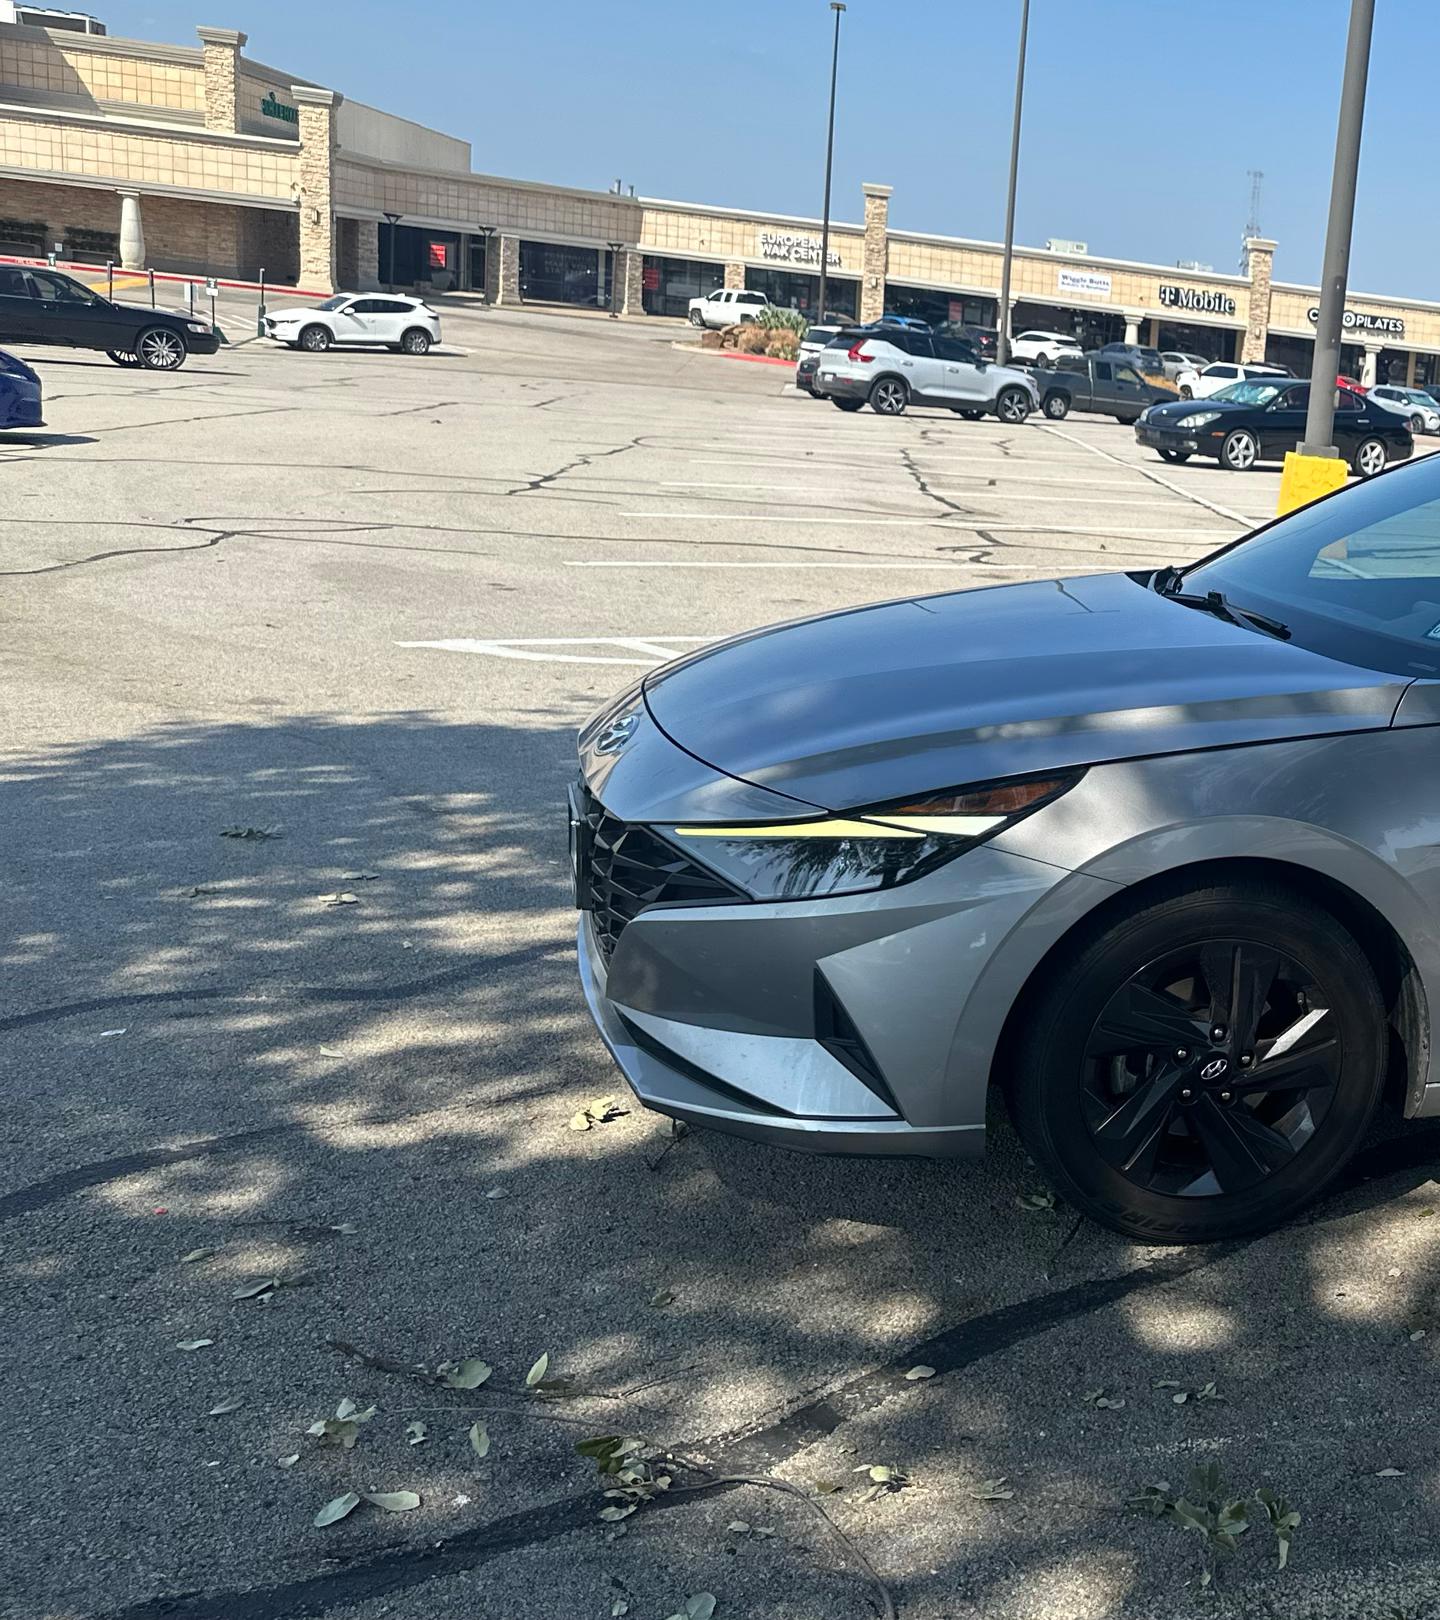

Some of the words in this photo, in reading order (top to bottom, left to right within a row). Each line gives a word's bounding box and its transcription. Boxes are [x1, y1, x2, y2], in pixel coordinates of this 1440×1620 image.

[761, 233, 824, 249] EUROPEAN
[791, 246, 840, 263] CENTER
[1355, 314, 1404, 332] PILATES
